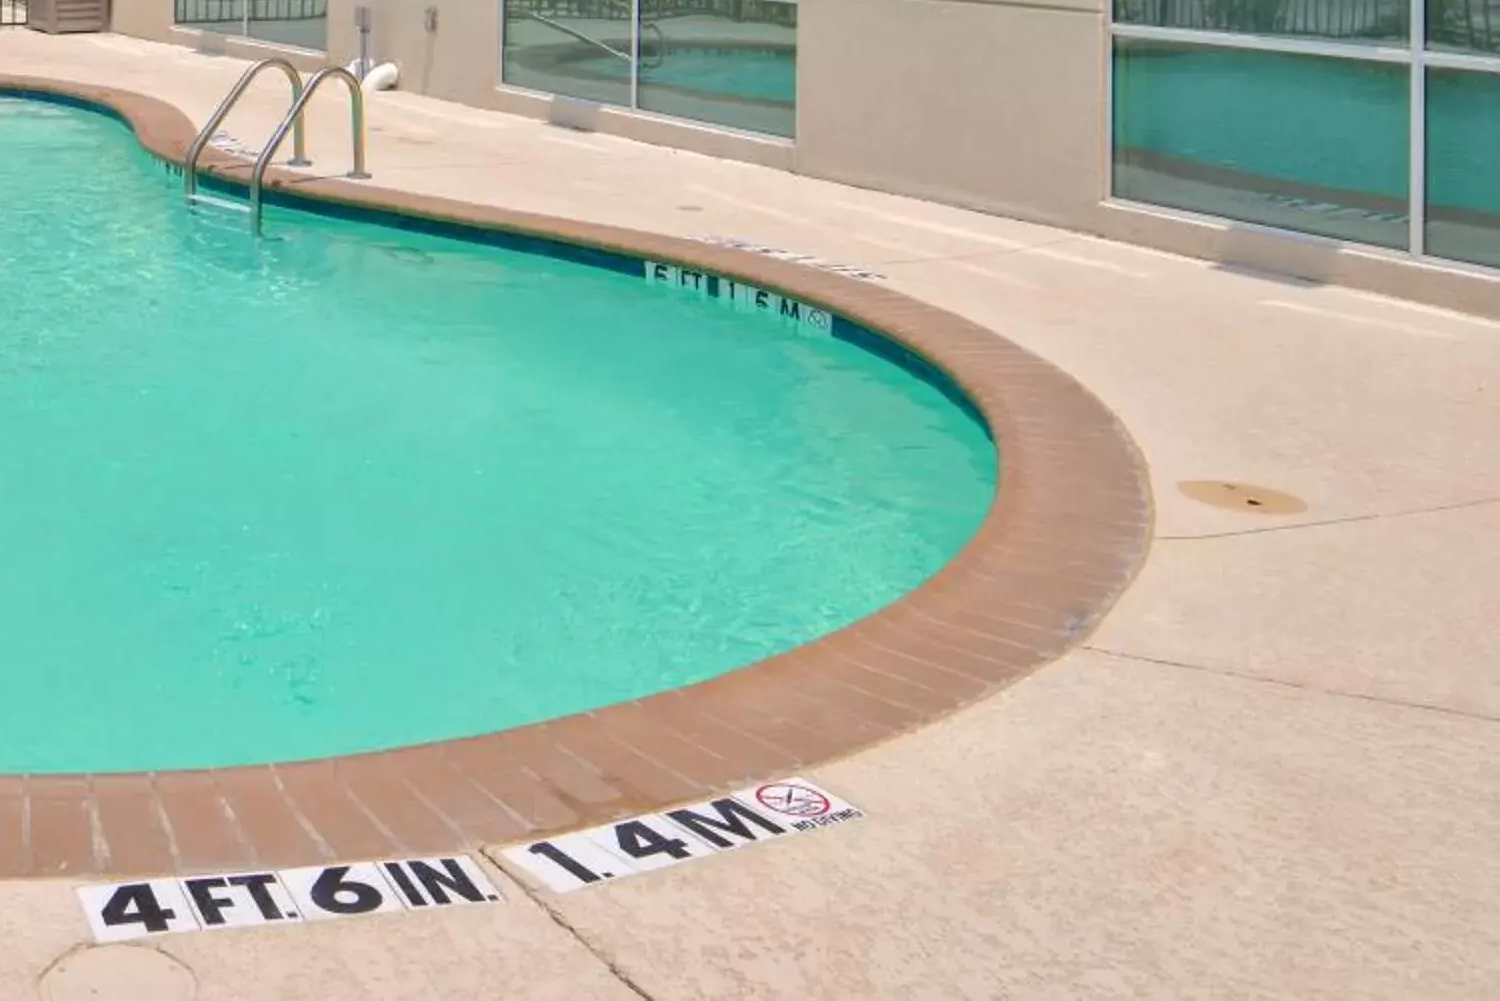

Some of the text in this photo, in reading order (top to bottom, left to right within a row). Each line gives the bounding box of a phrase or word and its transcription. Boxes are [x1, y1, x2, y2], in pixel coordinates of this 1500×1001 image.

[101, 858, 500, 932] 4 FT. 6 IN.
